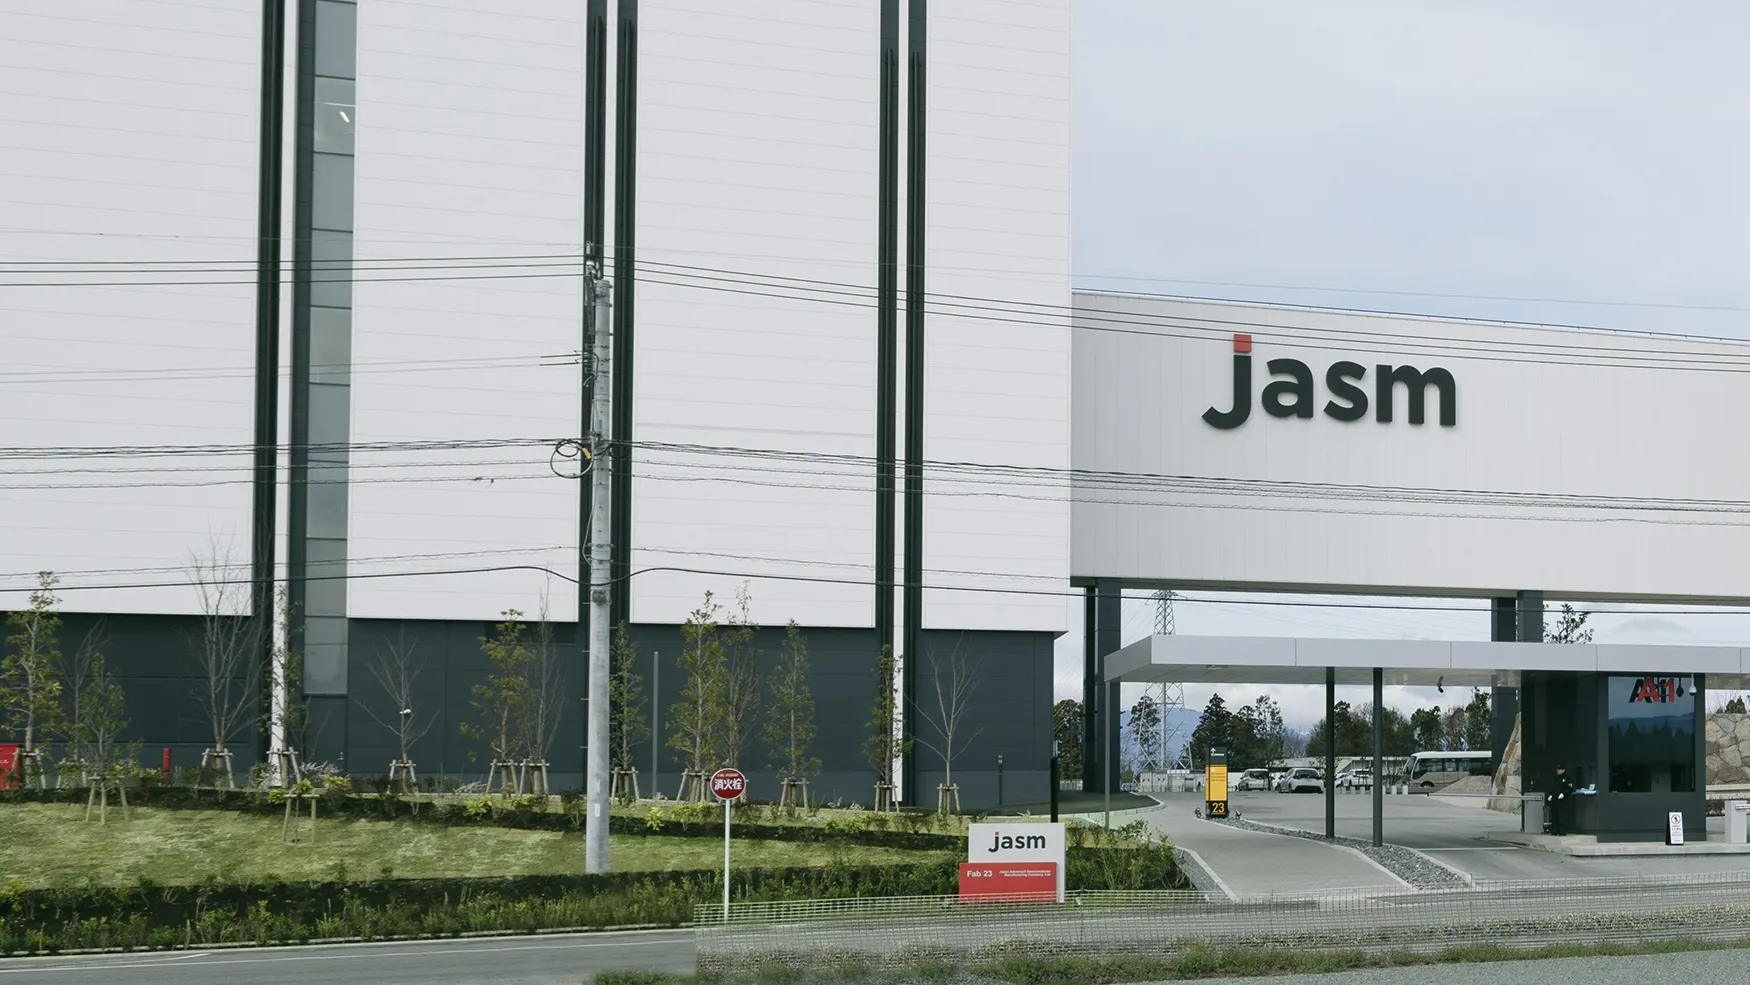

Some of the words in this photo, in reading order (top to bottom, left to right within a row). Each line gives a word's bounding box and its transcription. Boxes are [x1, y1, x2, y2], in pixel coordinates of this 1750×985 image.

[1202, 334, 1456, 429] jasm
[1636, 677, 1675, 703] A1
[714, 778, 742, 790] 消火栓
[1212, 802, 1225, 813] 23
[988, 831, 1046, 853] jasm
[983, 869, 993, 877] 23
